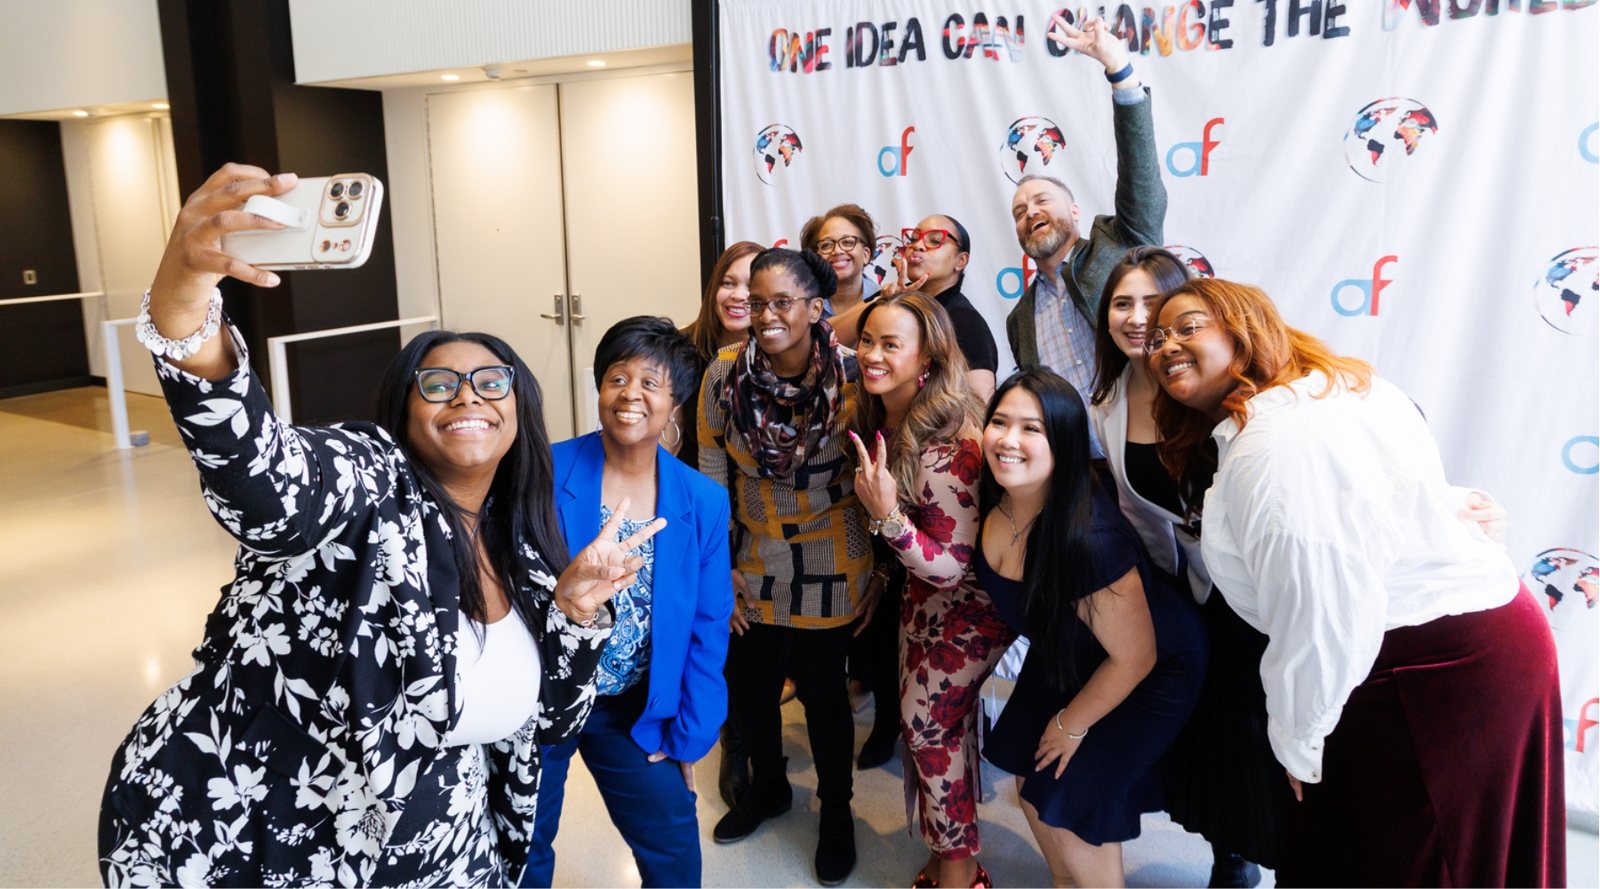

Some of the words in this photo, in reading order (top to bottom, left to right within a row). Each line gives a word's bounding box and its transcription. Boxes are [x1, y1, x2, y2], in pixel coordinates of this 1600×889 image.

[769, 27, 832, 74] ONE
[846, 17, 926, 69] IDEA
[942, 12, 1025, 62] CAN
[1257, 0, 1350, 47] THE
[878, 126, 915, 177] af
[1166, 117, 1224, 177] af
[1330, 255, 1398, 316] af
